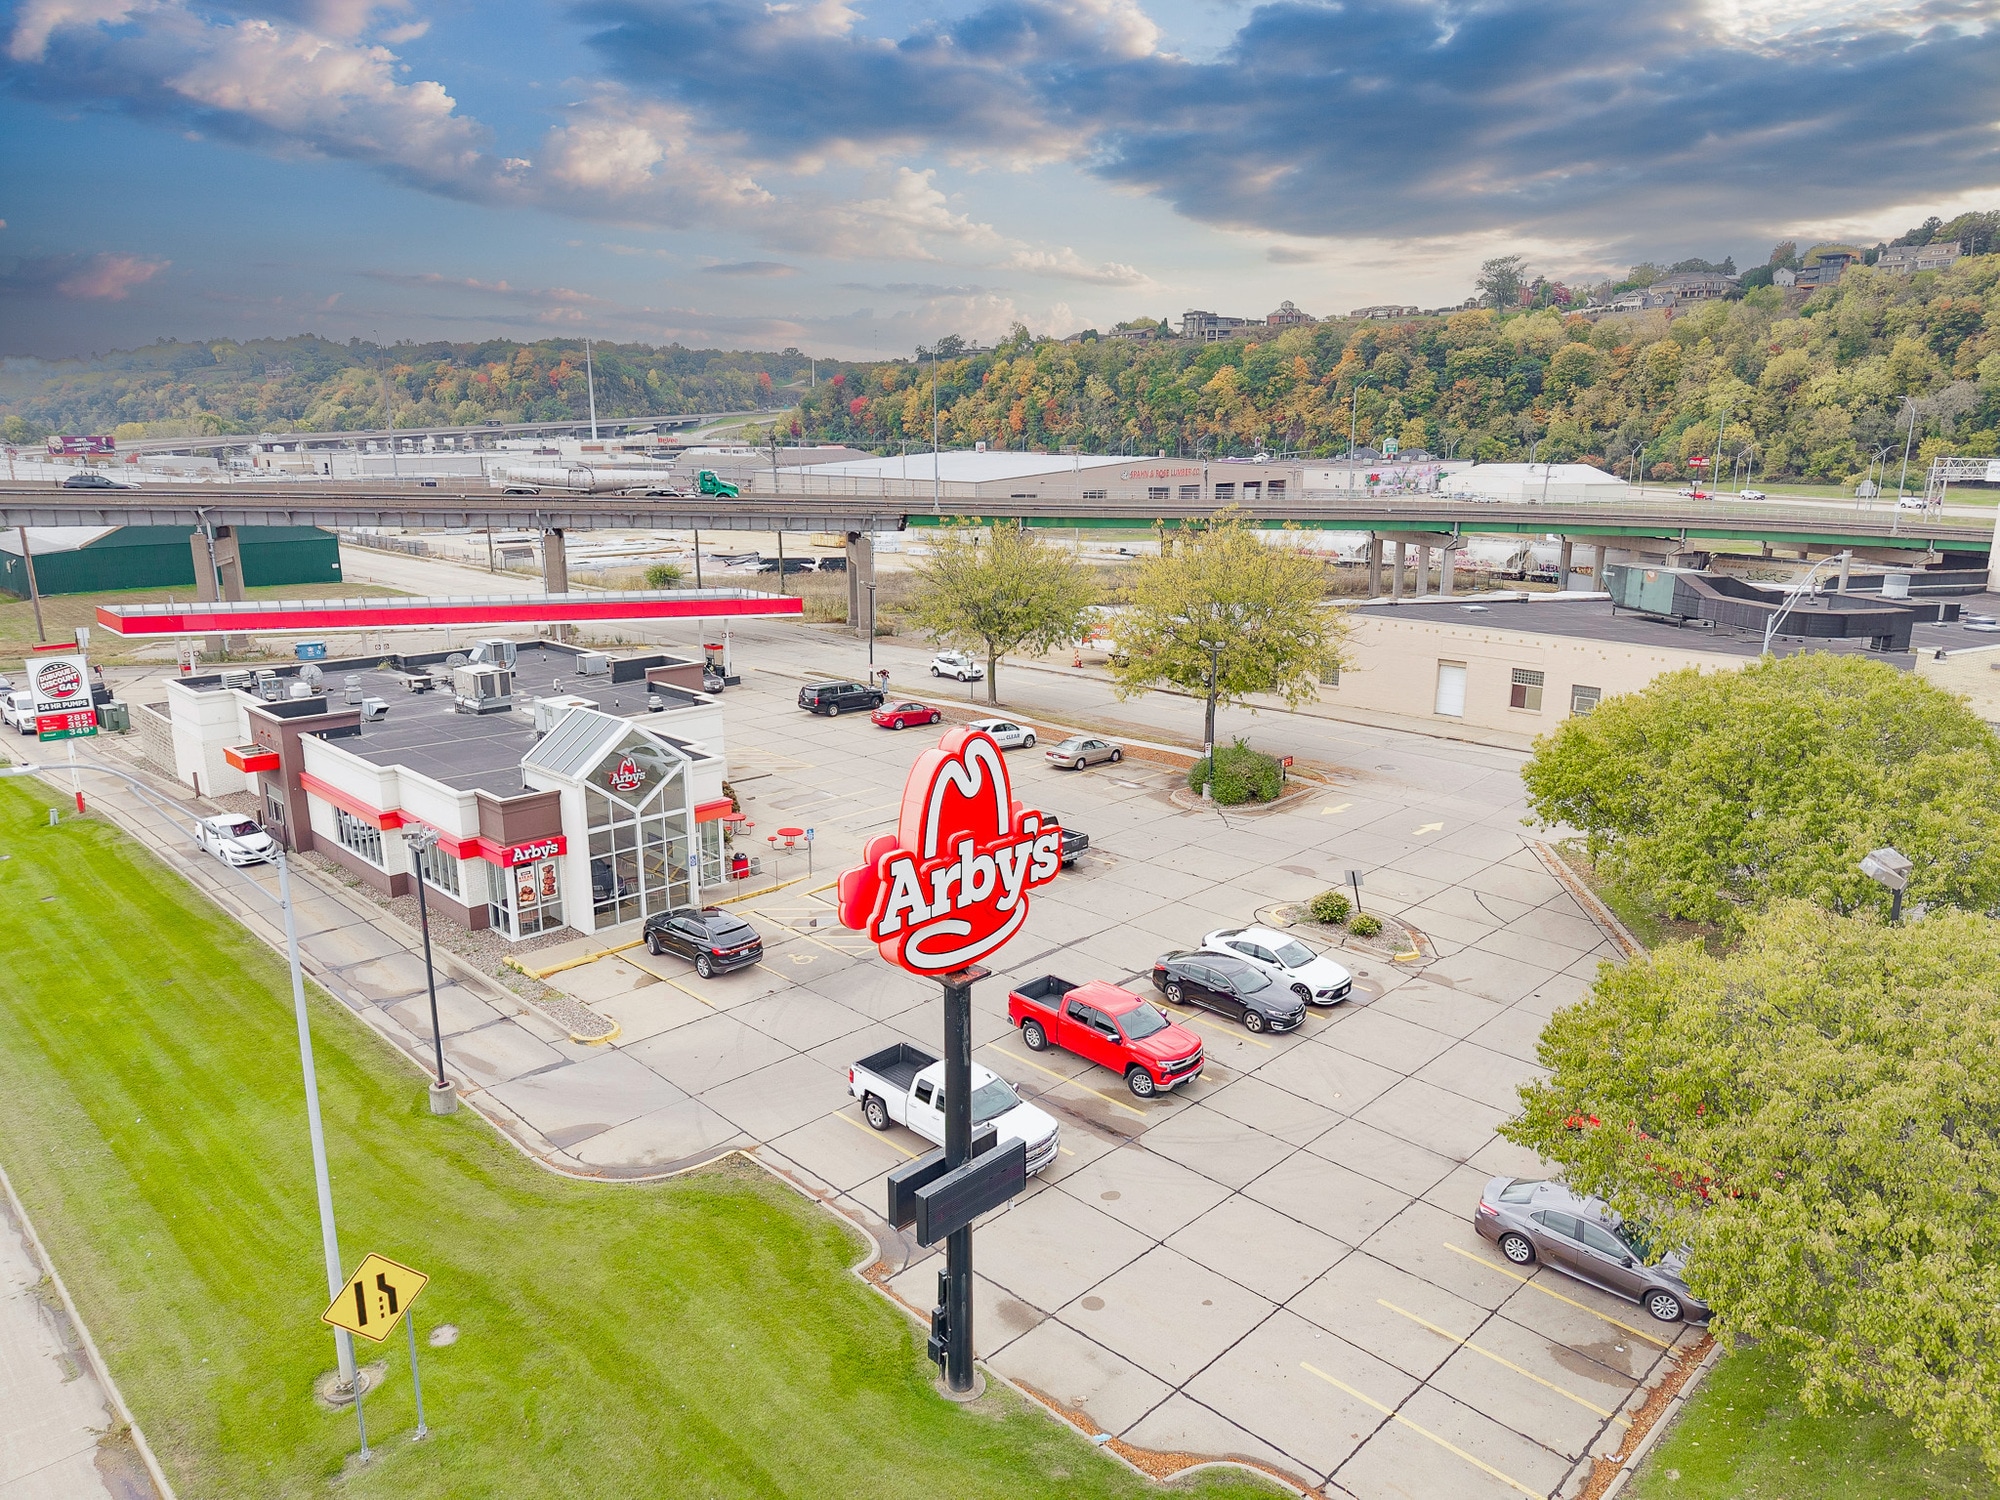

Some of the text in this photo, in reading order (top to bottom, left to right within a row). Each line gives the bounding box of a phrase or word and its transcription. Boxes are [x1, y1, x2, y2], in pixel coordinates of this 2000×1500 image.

[1130, 470, 1149, 479] SPAHN
[1156, 469, 1169, 478] ROSE
[1171, 467, 1192, 477] LUMBER
[41, 673, 78, 690] DISCOUNT
[59, 682, 78, 691] GAS
[62, 700, 88, 708] PUMPS
[611, 769, 646, 785] Arby's
[512, 841, 558, 862] Arby's
[878, 816, 1060, 937] Arby's
